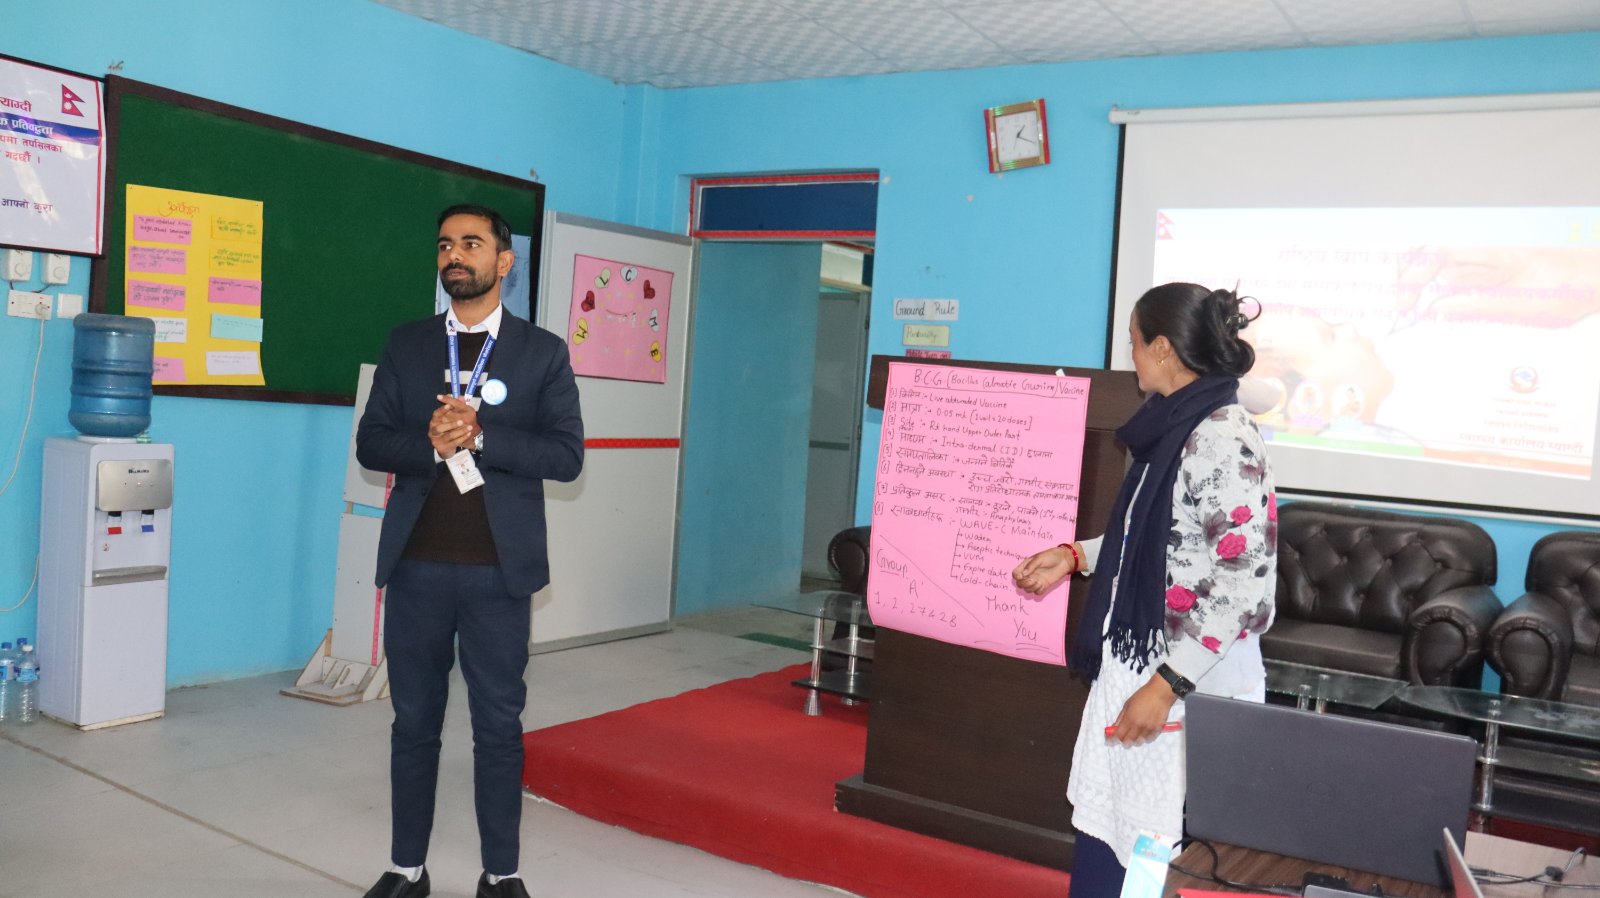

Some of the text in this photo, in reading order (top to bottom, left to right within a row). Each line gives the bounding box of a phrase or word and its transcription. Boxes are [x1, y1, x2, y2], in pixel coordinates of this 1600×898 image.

[0, 97, 32, 112] याग्दी
[895, 299, 926, 317] Ground
[1059, 381, 1085, 396] Vaccine
[979, 399, 1008, 409] Vaccine
[962, 426, 983, 437] Upper
[1011, 525, 1055, 541] Maintain
[985, 594, 1030, 616] Thank
[1013, 618, 1038, 644] You
